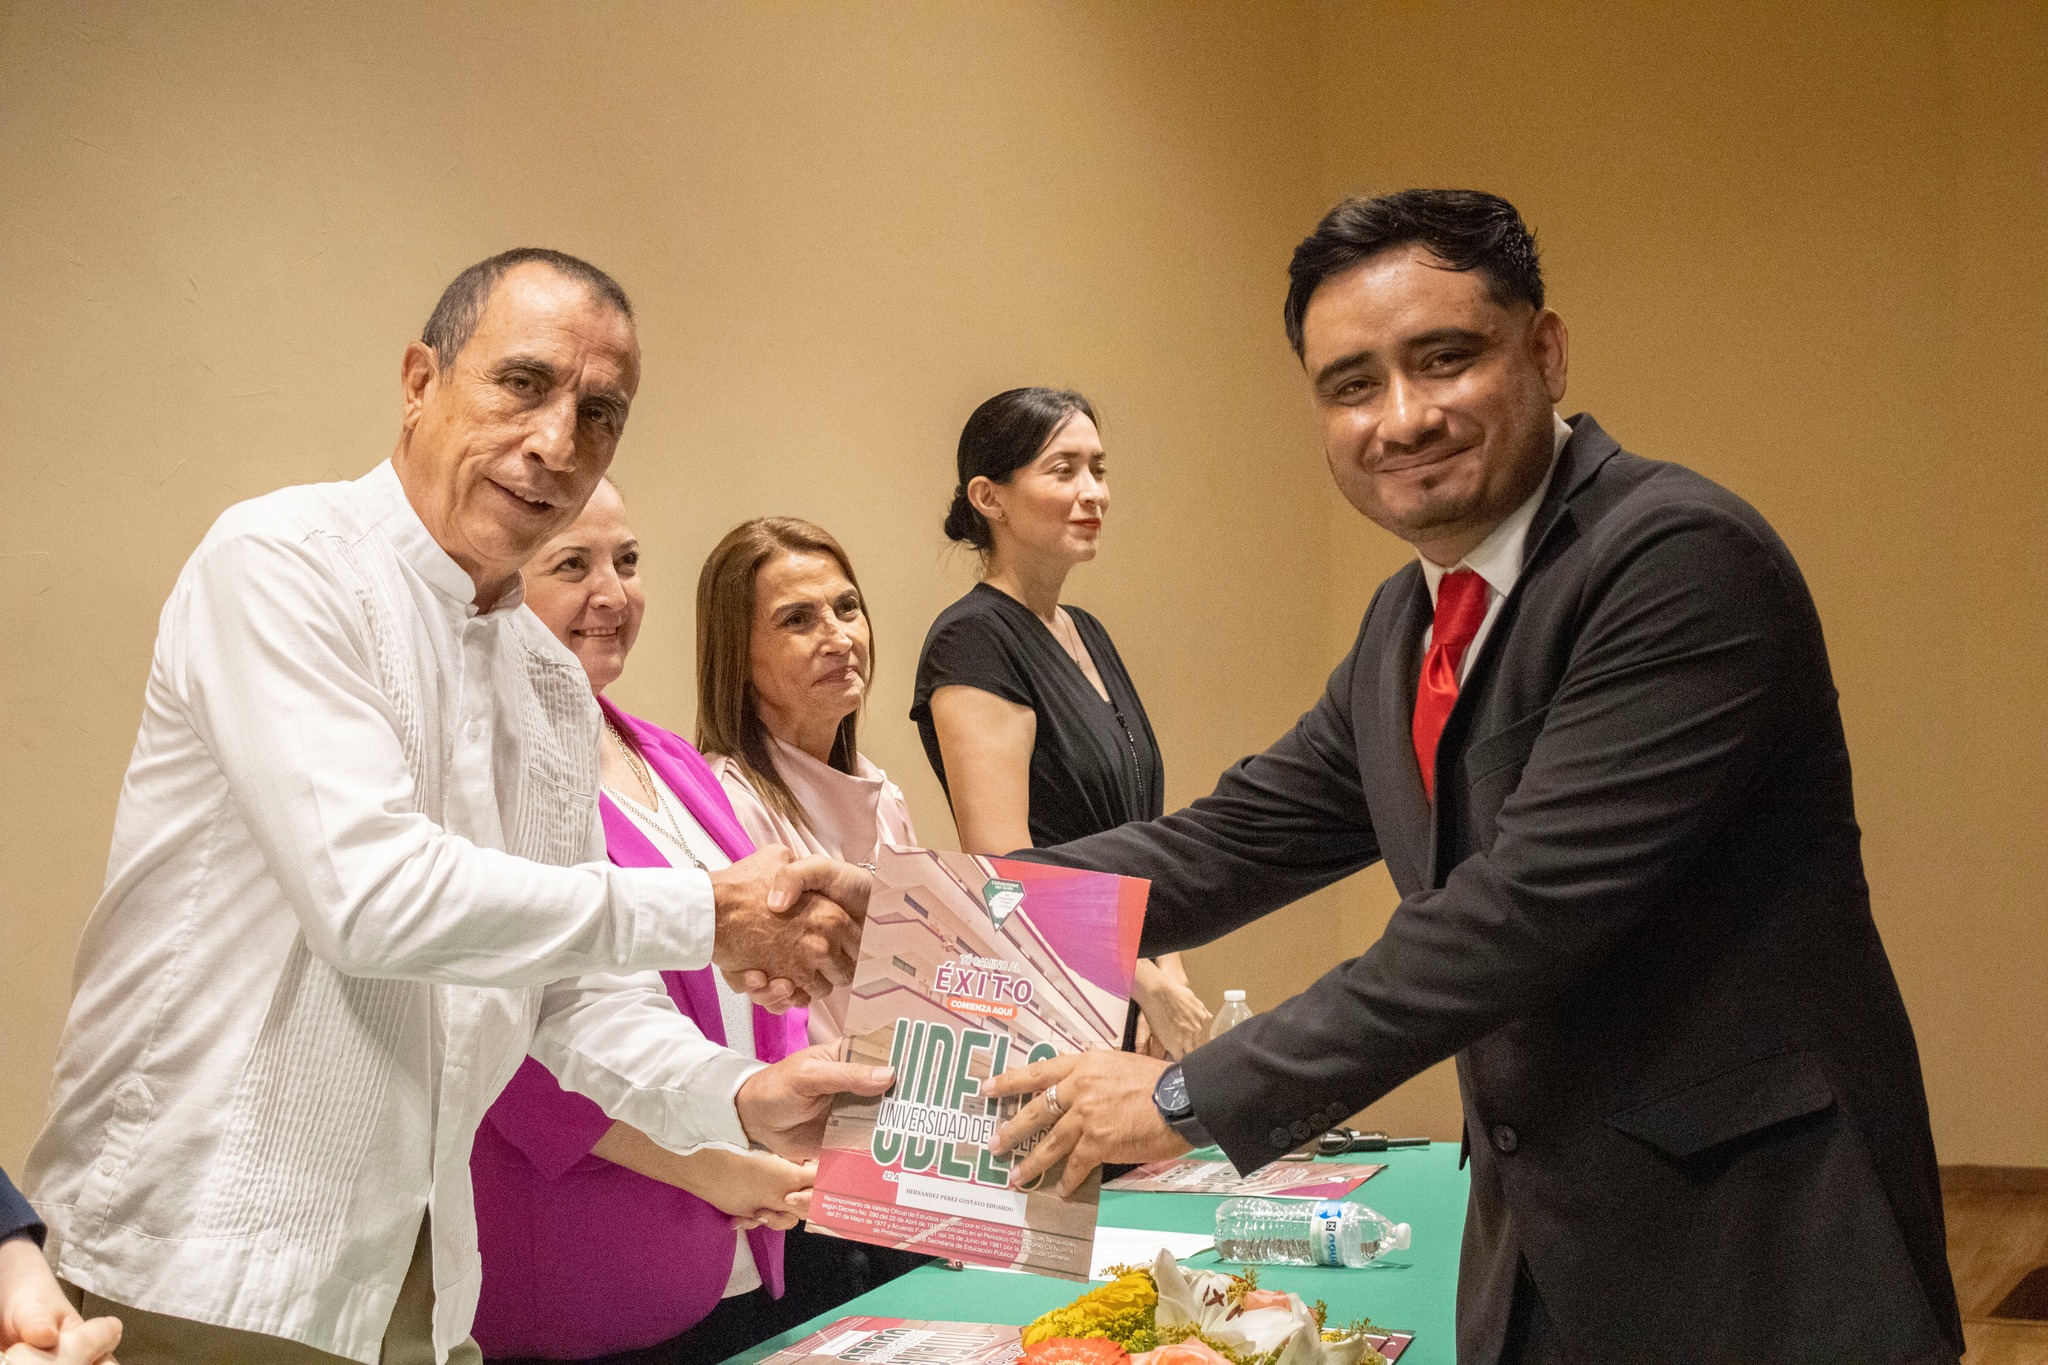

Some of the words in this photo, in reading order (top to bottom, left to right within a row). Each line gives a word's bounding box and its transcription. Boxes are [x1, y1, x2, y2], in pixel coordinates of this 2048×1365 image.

[973, 956, 1008, 971] CAMINO
[934, 961, 1034, 1005] ÉXITO
[951, 1000, 991, 1014] COMIENZA
[992, 1007, 1013, 1017] AQUÍ
[879, 1101, 968, 1140] UNIVERSIDAD
[906, 1188, 939, 1198] HERNANDEZ
[940, 1193, 957, 1201] PEREZ
[959, 1197, 983, 1206] GUSTAVO
[985, 1201, 1013, 1211] EDUARDO
[822, 1203, 837, 1211] según
[838, 1206, 857, 1214] Decreto
[823, 1195, 863, 1207] Reconocimiento
[871, 1204, 889, 1212] Validez
[915, 1212, 939, 1221] Estudios
[980, 1224, 1006, 1234] Gobierno
[850, 1215, 864, 1223] Mayo
[891, 1223, 914, 1231] Acuerdo
[963, 1244, 992, 1253] Educación
